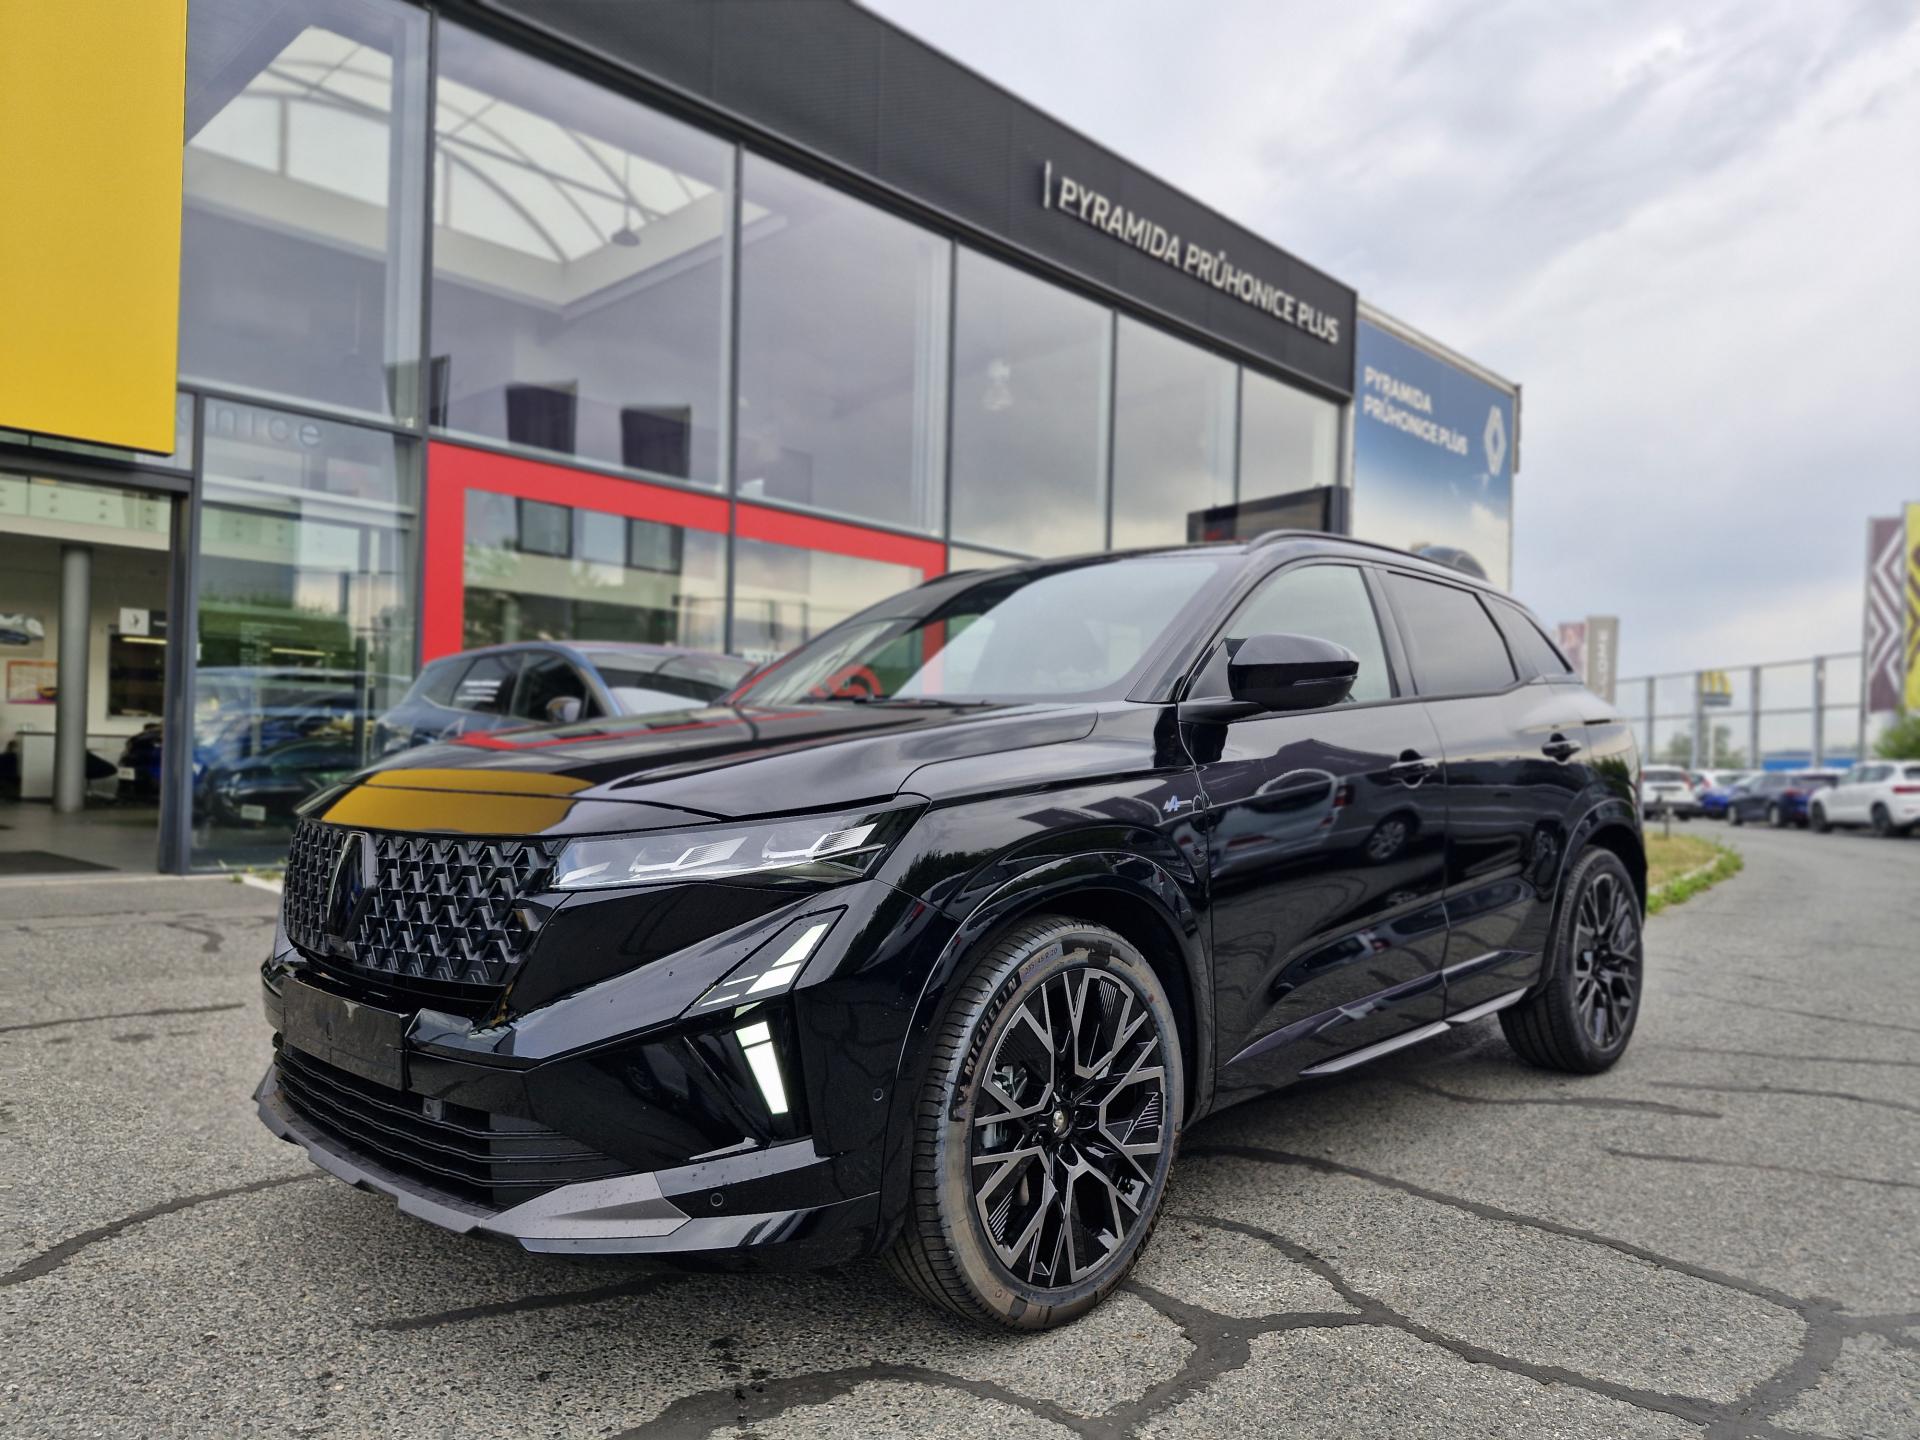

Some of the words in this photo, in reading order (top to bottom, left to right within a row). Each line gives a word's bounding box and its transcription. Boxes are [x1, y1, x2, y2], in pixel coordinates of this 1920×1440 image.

[1058, 176, 1180, 268] PYRAMIDA
[1183, 243, 1296, 325] PRŮHONICE
[1297, 301, 1339, 344] PLUS
[1364, 365, 1432, 414] PYRAMIDA
[964, 976, 1017, 1076] MICHELIN
